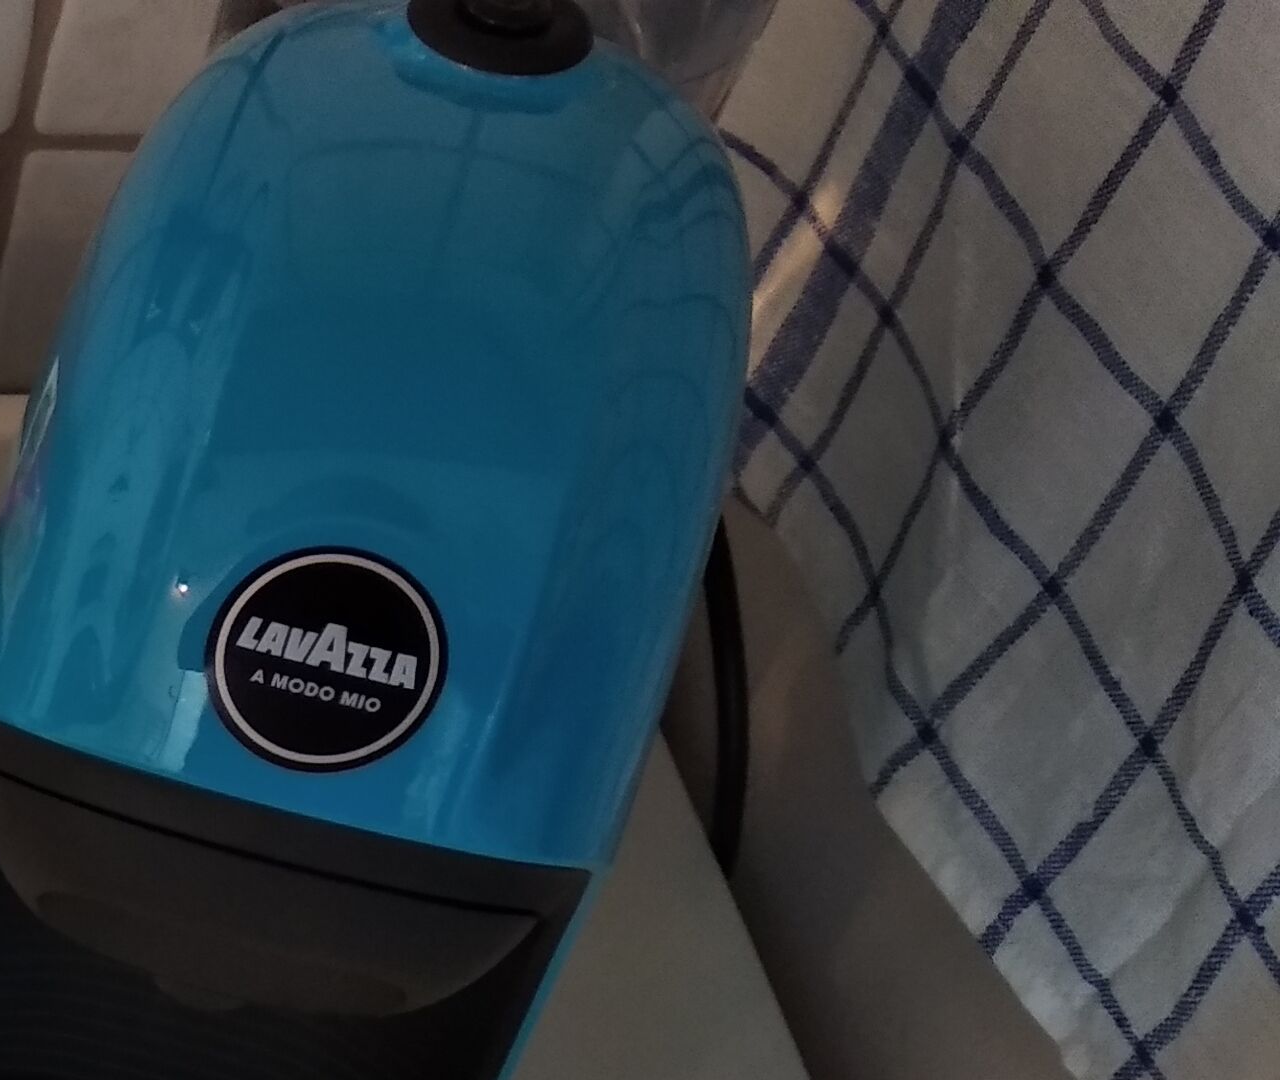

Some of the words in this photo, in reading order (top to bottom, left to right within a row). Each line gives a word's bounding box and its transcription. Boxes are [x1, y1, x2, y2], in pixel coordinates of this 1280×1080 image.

[236, 616, 418, 690] LAVAZZA
[249, 669, 265, 685] A
[271, 674, 336, 702] MODO
[339, 690, 382, 713] MIO
